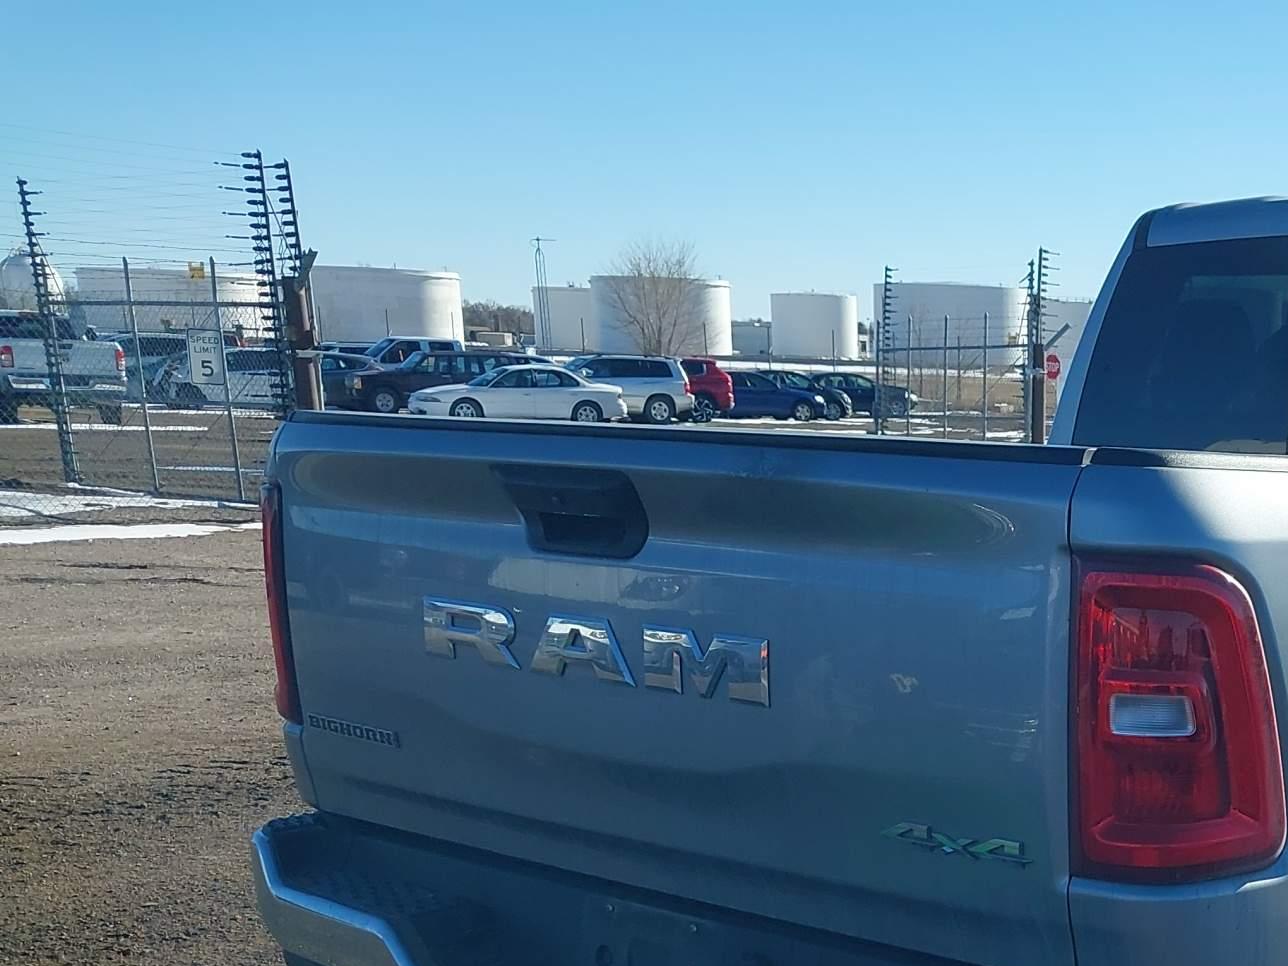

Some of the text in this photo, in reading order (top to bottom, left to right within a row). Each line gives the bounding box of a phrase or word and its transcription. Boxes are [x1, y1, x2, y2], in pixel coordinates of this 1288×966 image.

[190, 335, 219, 344] SPEED
[201, 359, 214, 377] 5
[423, 595, 771, 708] RAM
